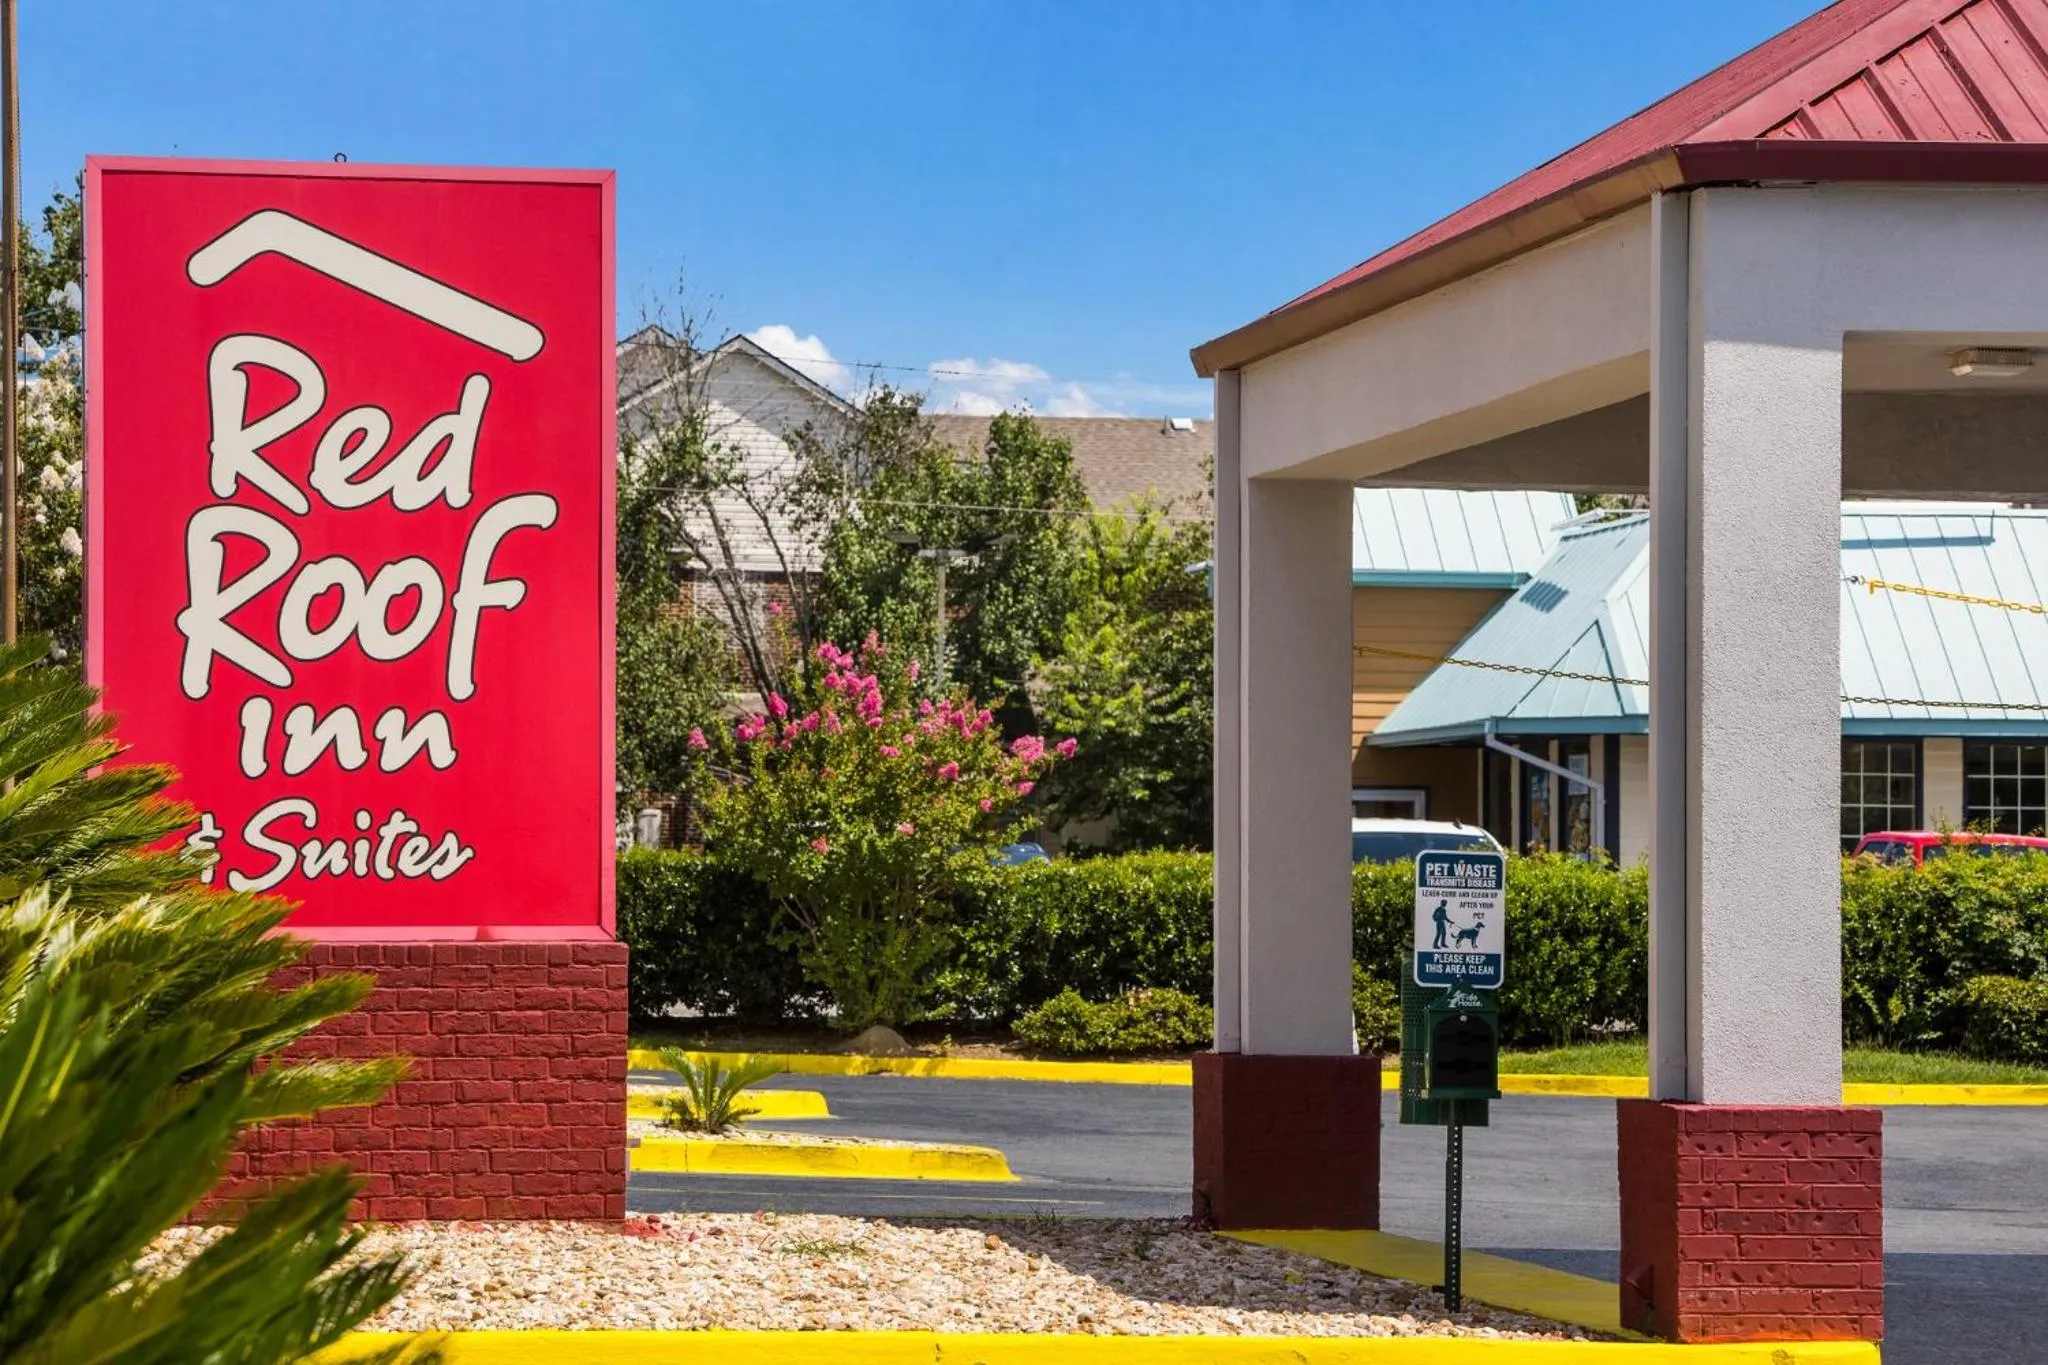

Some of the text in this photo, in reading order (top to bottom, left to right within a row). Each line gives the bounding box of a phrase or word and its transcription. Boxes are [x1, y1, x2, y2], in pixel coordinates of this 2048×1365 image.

[208, 333, 491, 516] Red
[176, 493, 558, 701] Roof
[227, 796, 475, 893] Suites
[1426, 863, 1497, 877] PET WASTE
[1426, 878, 1496, 888] TRANSMITS DISEASE
[1459, 901, 1477, 909] AFTER
[1433, 953, 1487, 964] PLEASE KEEP
[1424, 963, 1495, 975] THIS AREA CLEAN
